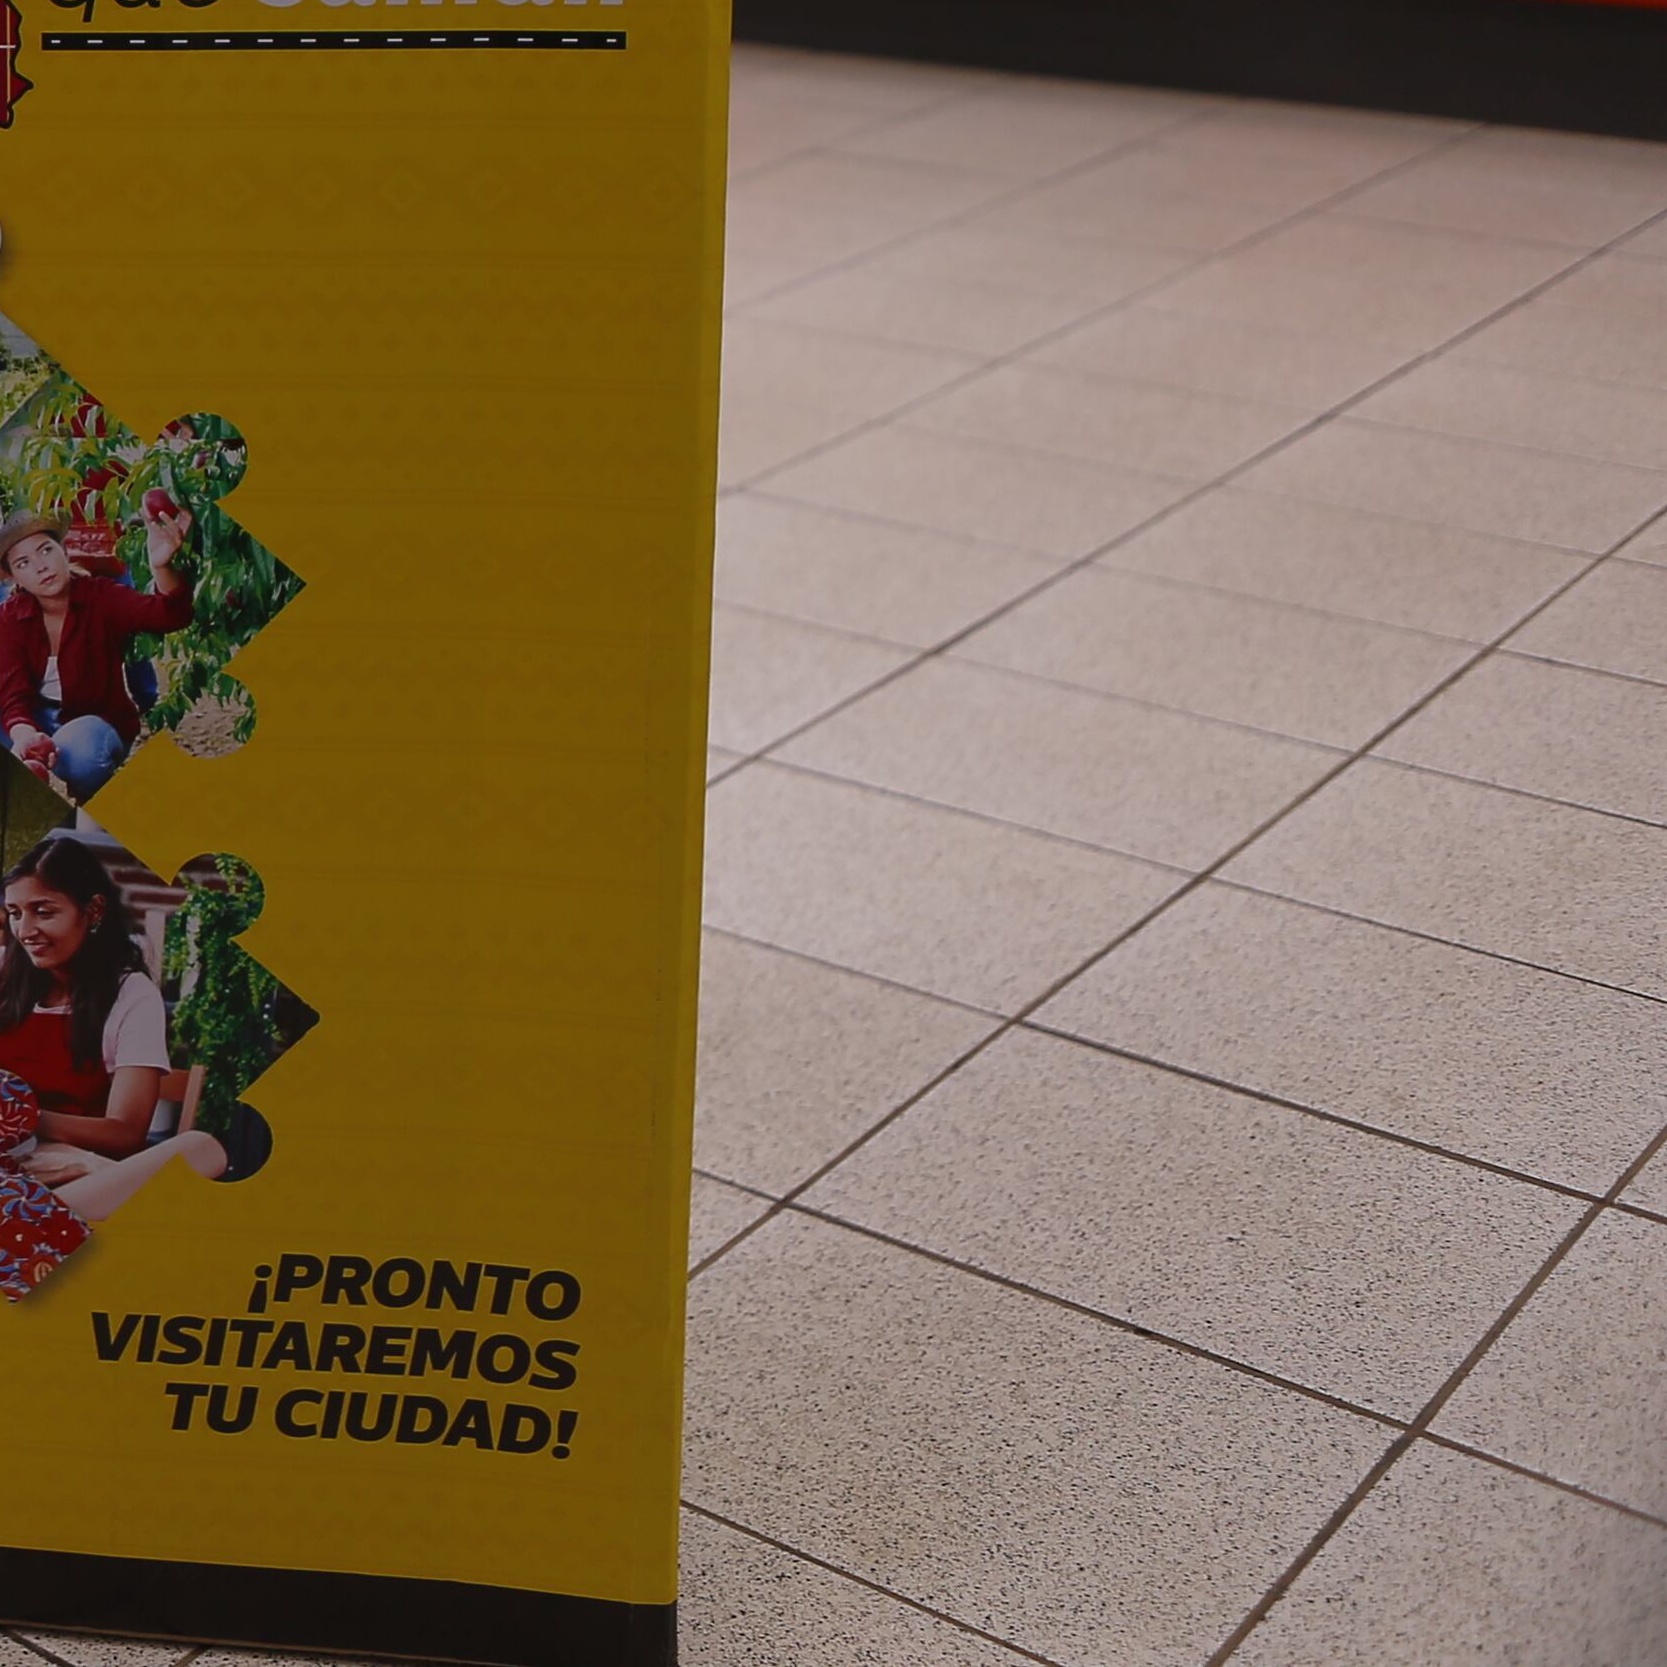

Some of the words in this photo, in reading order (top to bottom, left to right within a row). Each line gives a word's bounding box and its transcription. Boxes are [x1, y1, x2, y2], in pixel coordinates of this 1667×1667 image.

[246, 1252, 582, 1322] ¡PRONTO
[90, 1311, 581, 1391] VISITAREMOS
[164, 1381, 260, 1435] TU
[273, 1388, 580, 1461] CIUDAD!
